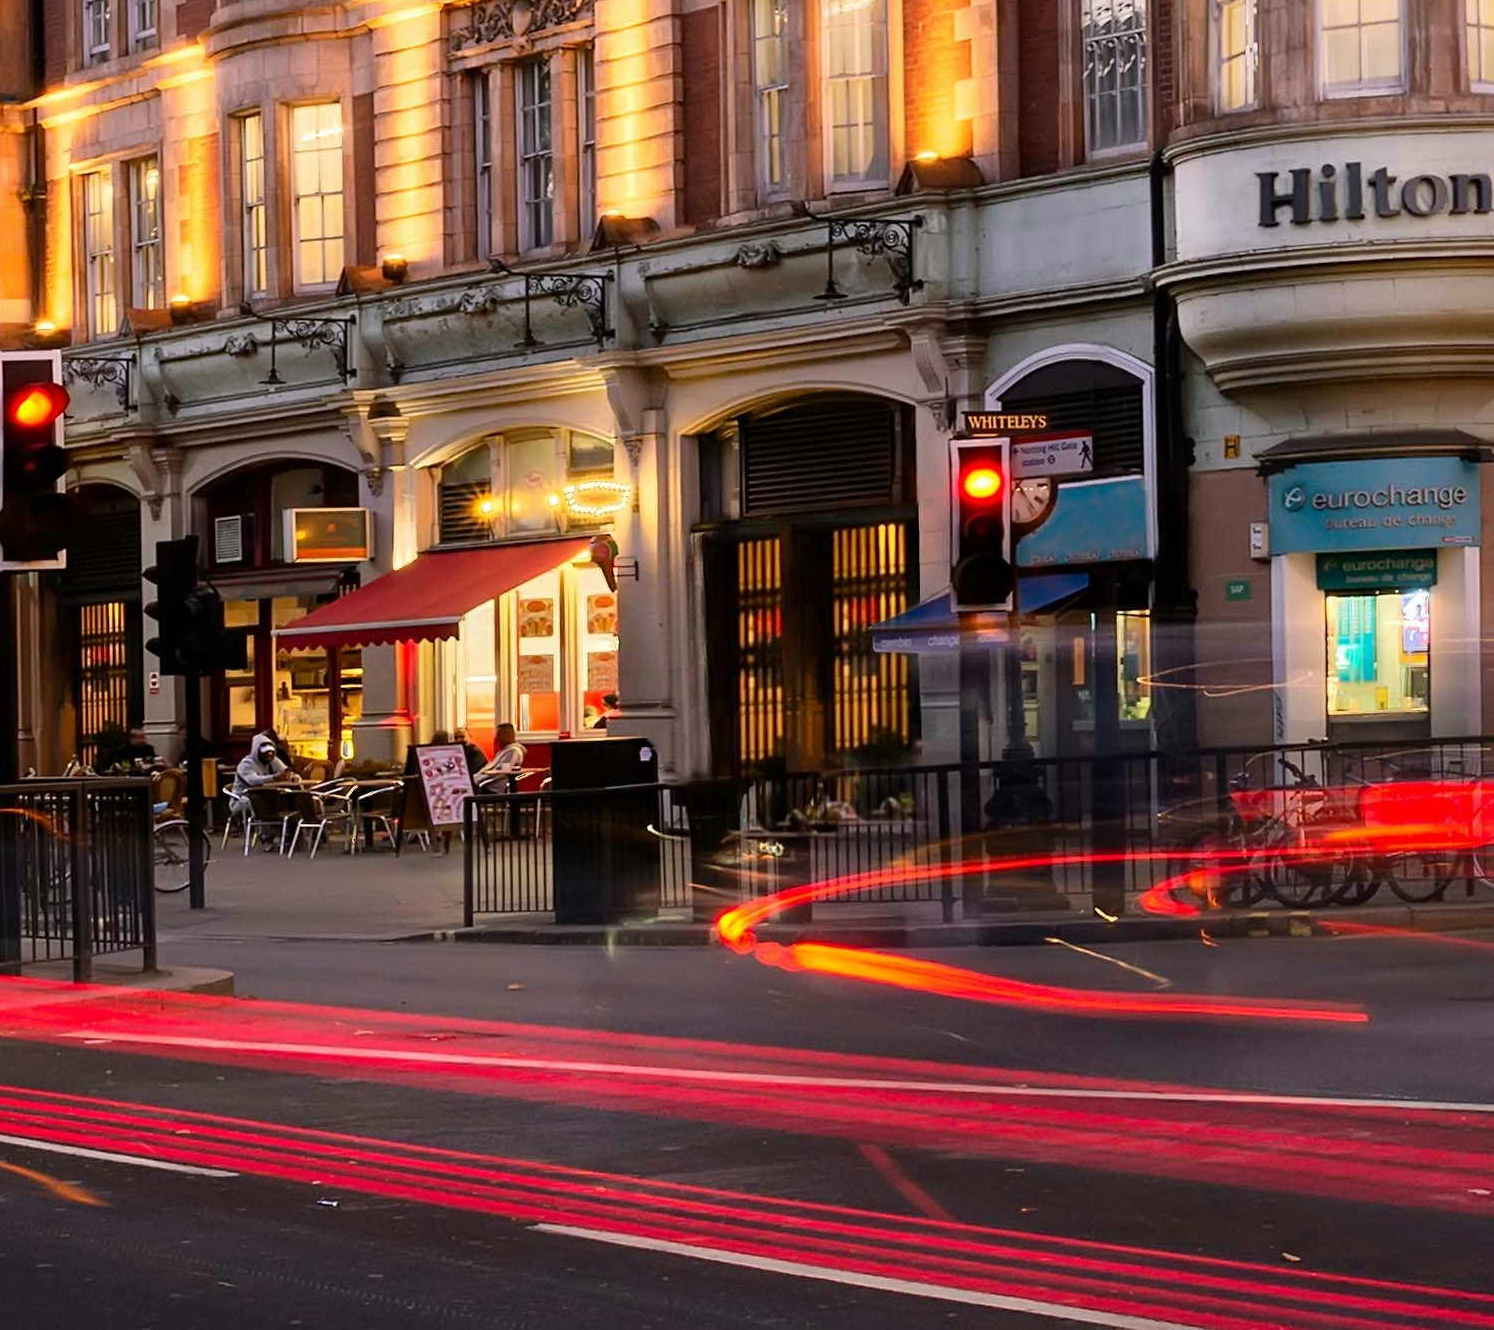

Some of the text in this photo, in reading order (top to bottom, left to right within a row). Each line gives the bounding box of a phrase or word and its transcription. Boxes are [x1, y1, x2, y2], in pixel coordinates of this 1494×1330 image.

[1254, 161, 1494, 228] Hilton
[968, 415, 1047, 430] WHITELEYS
[1311, 484, 1468, 510] eurochange
[1382, 515, 1402, 528] de
[1407, 513, 1457, 528] change
[1341, 556, 1435, 571] eurochange
